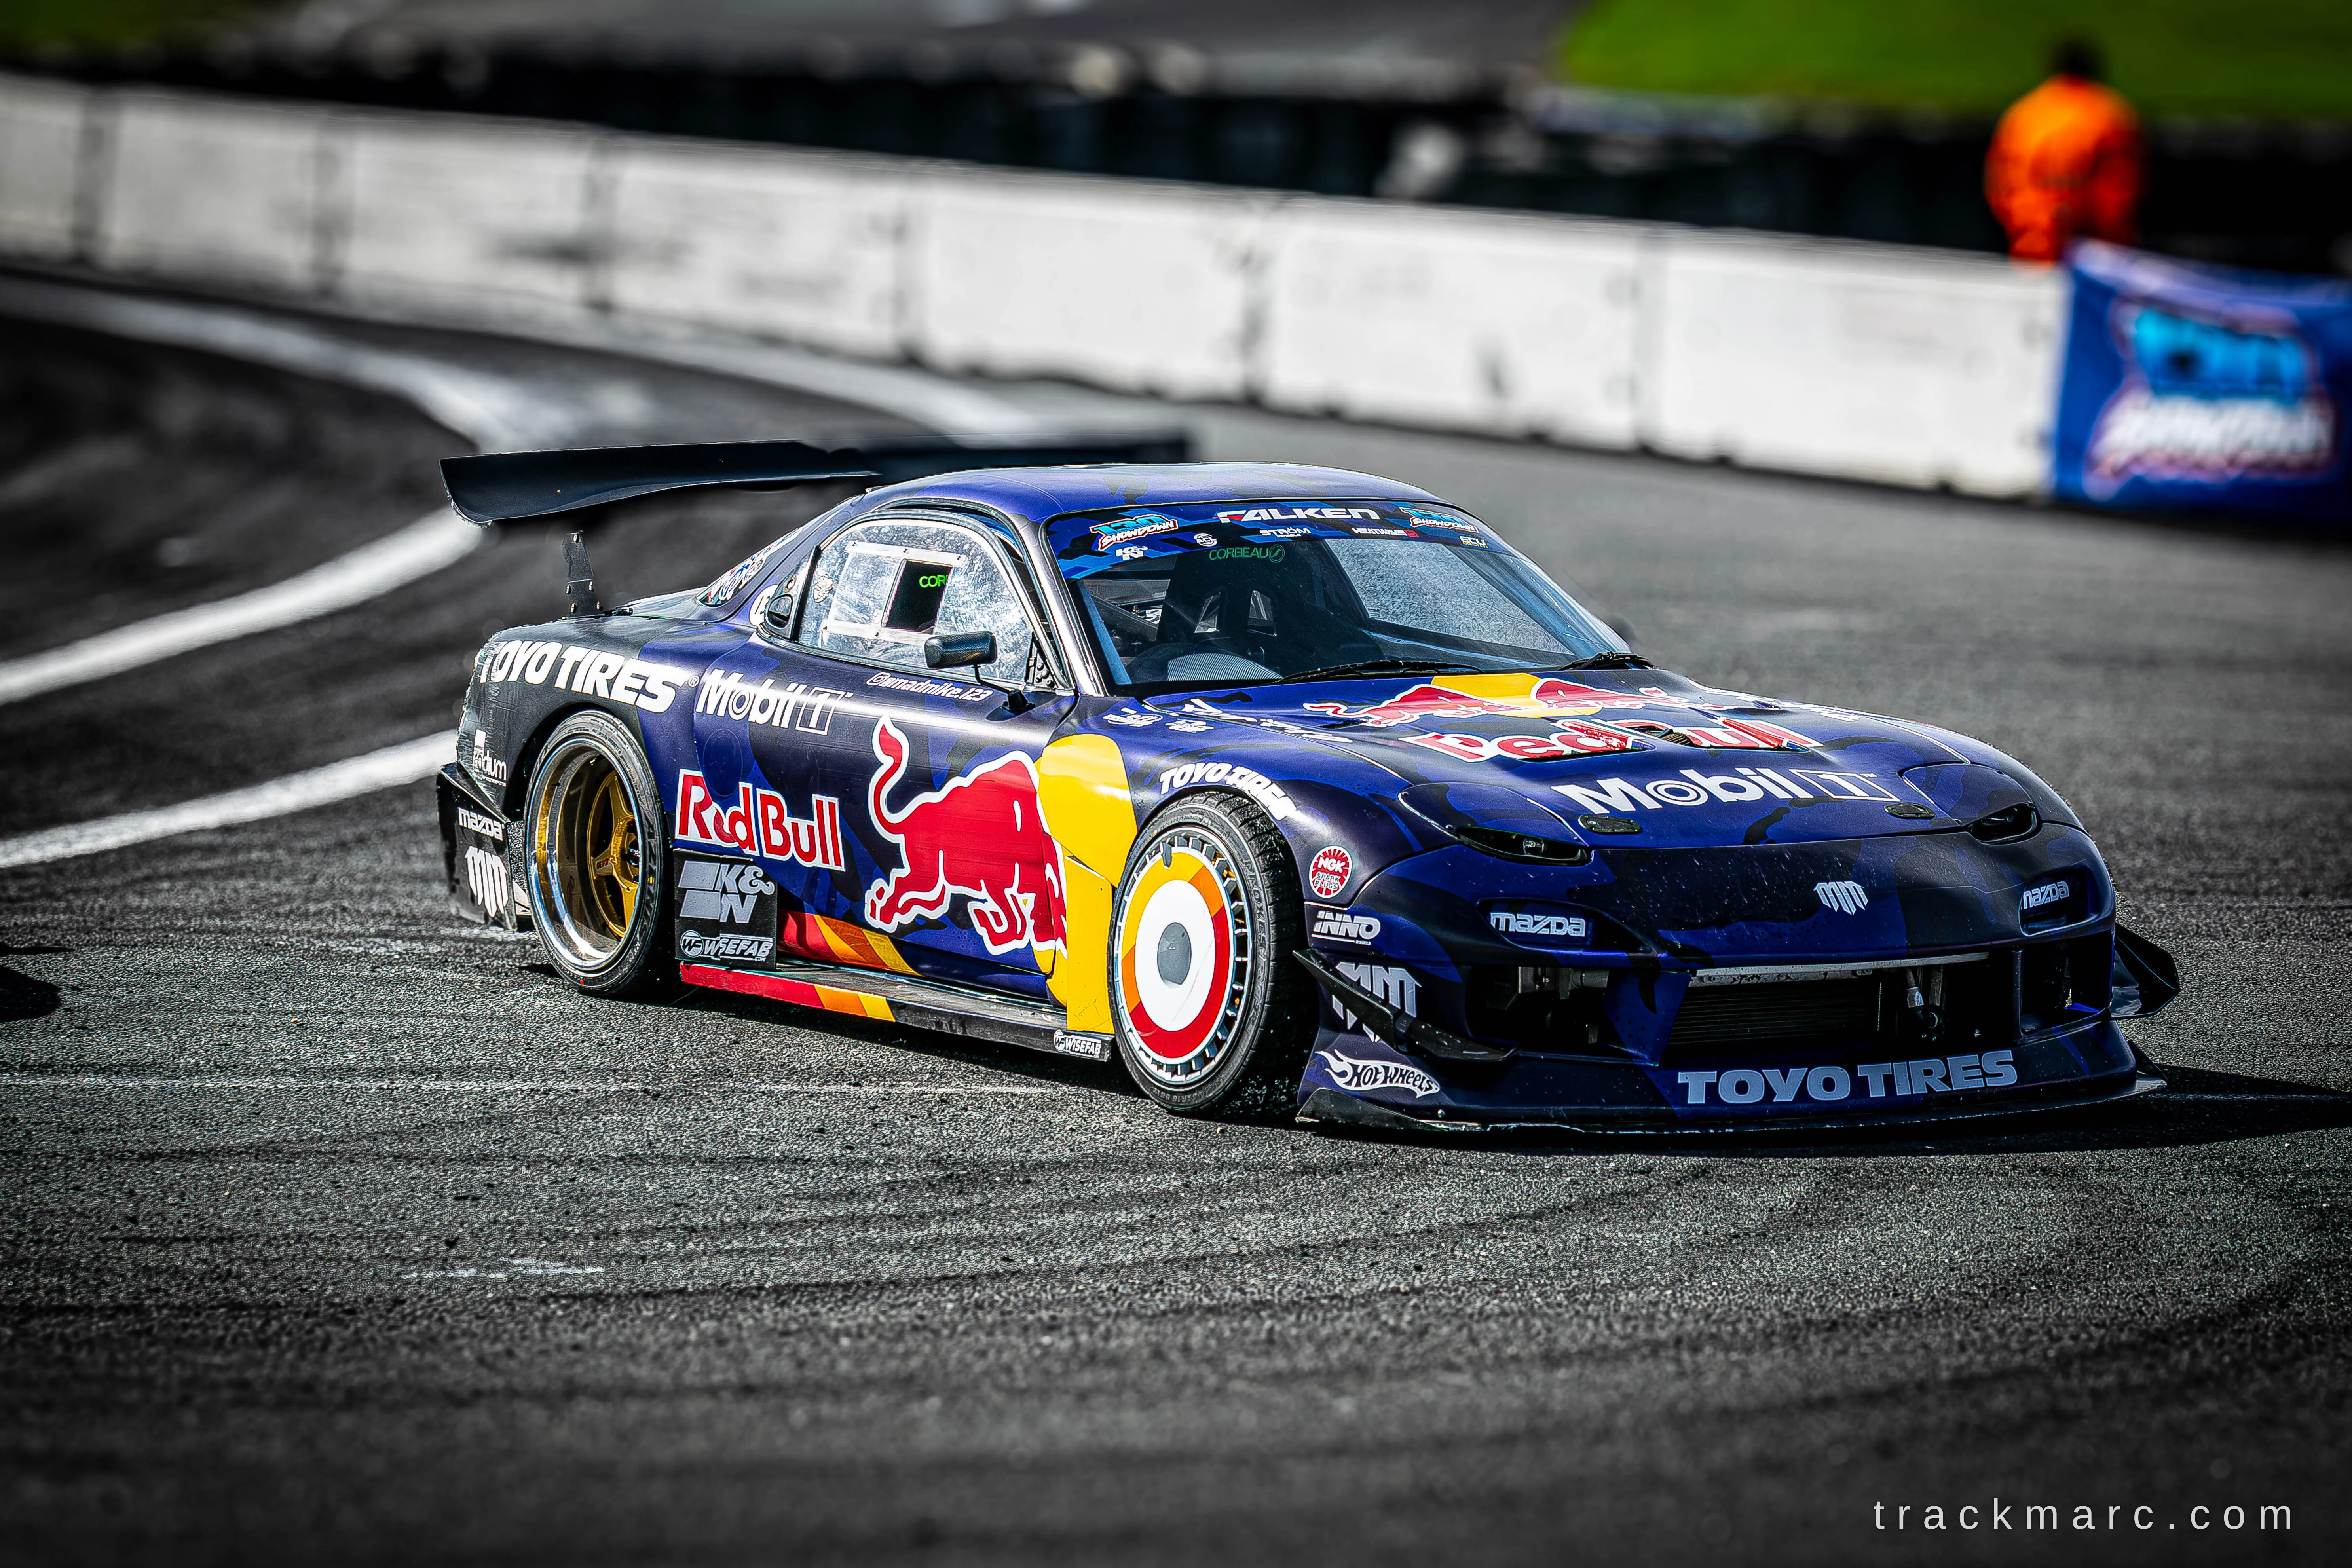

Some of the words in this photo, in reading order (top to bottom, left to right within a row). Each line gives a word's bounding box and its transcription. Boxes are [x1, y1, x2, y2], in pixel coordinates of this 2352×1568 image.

[1217, 508, 1381, 523] FALKEN
[1413, 518, 1475, 531] SHOWDOWN
[1093, 516, 1167, 534] 130
[1102, 521, 1174, 547] SHOWDOWN
[1259, 527, 1311, 535] STRÖM
[1352, 528, 1407, 536] HEATWAVE
[1460, 536, 1486, 545] ECU
[1209, 547, 1269, 560] CORBEAU
[919, 575, 949, 588] COR
[479, 640, 564, 685] TOYO
[696, 669, 808, 729] Mobil
[1160, 762, 1232, 795] TOYO
[1551, 767, 1814, 814] Mobil
[457, 807, 503, 841] mazda
[675, 769, 760, 856] Red
[756, 788, 845, 872] Bull
[1317, 856, 1346, 873] NGK
[1314, 879, 1338, 890] PLUGS
[1316, 873, 1340, 883] SPARK
[1313, 911, 1381, 940] INNO
[1490, 912, 1586, 936] mazda
[704, 938, 773, 957] WSEFAB
[1065, 1037, 1102, 1055] WISEFAB
[1343, 1061, 1383, 1088] HOT
[1678, 1066, 1850, 1104] TOYO
[1858, 1050, 2018, 1098] TIRES
